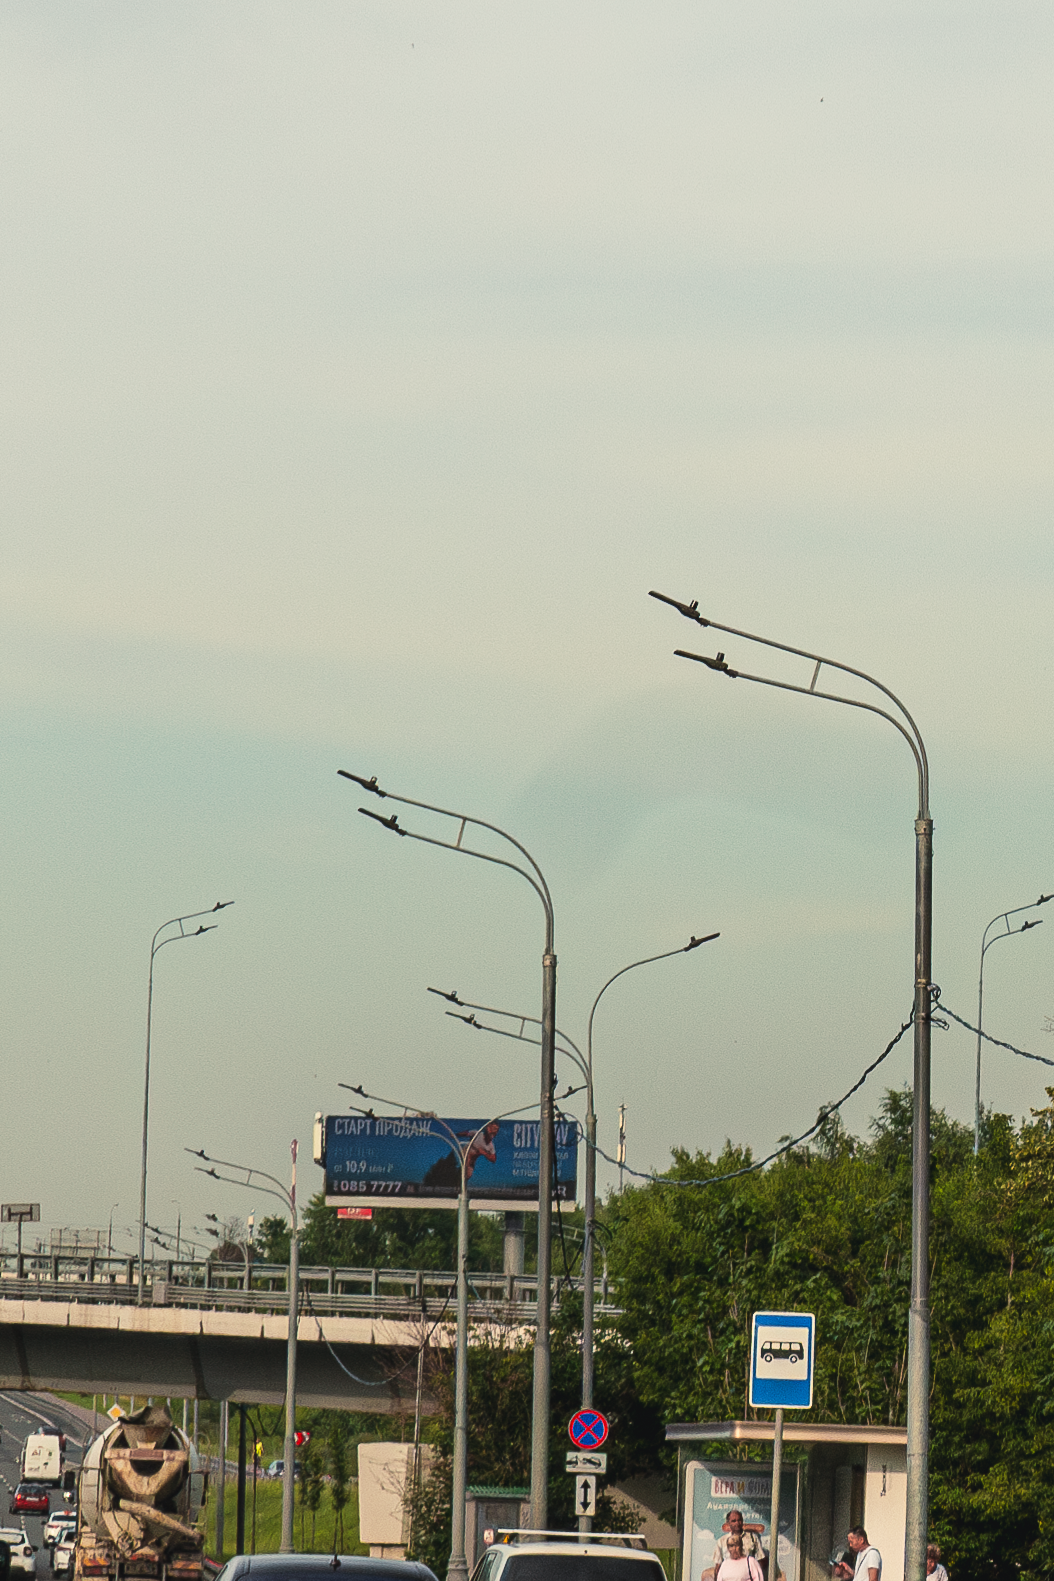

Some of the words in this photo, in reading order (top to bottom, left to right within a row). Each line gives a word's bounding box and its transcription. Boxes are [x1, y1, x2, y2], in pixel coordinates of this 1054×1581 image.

[334, 1118, 373, 1136] СТАРТ
[375, 1119, 433, 1139] ПРОДАЖ
[514, 1123, 541, 1148] CITY
[371, 1180, 402, 1193] 7777
